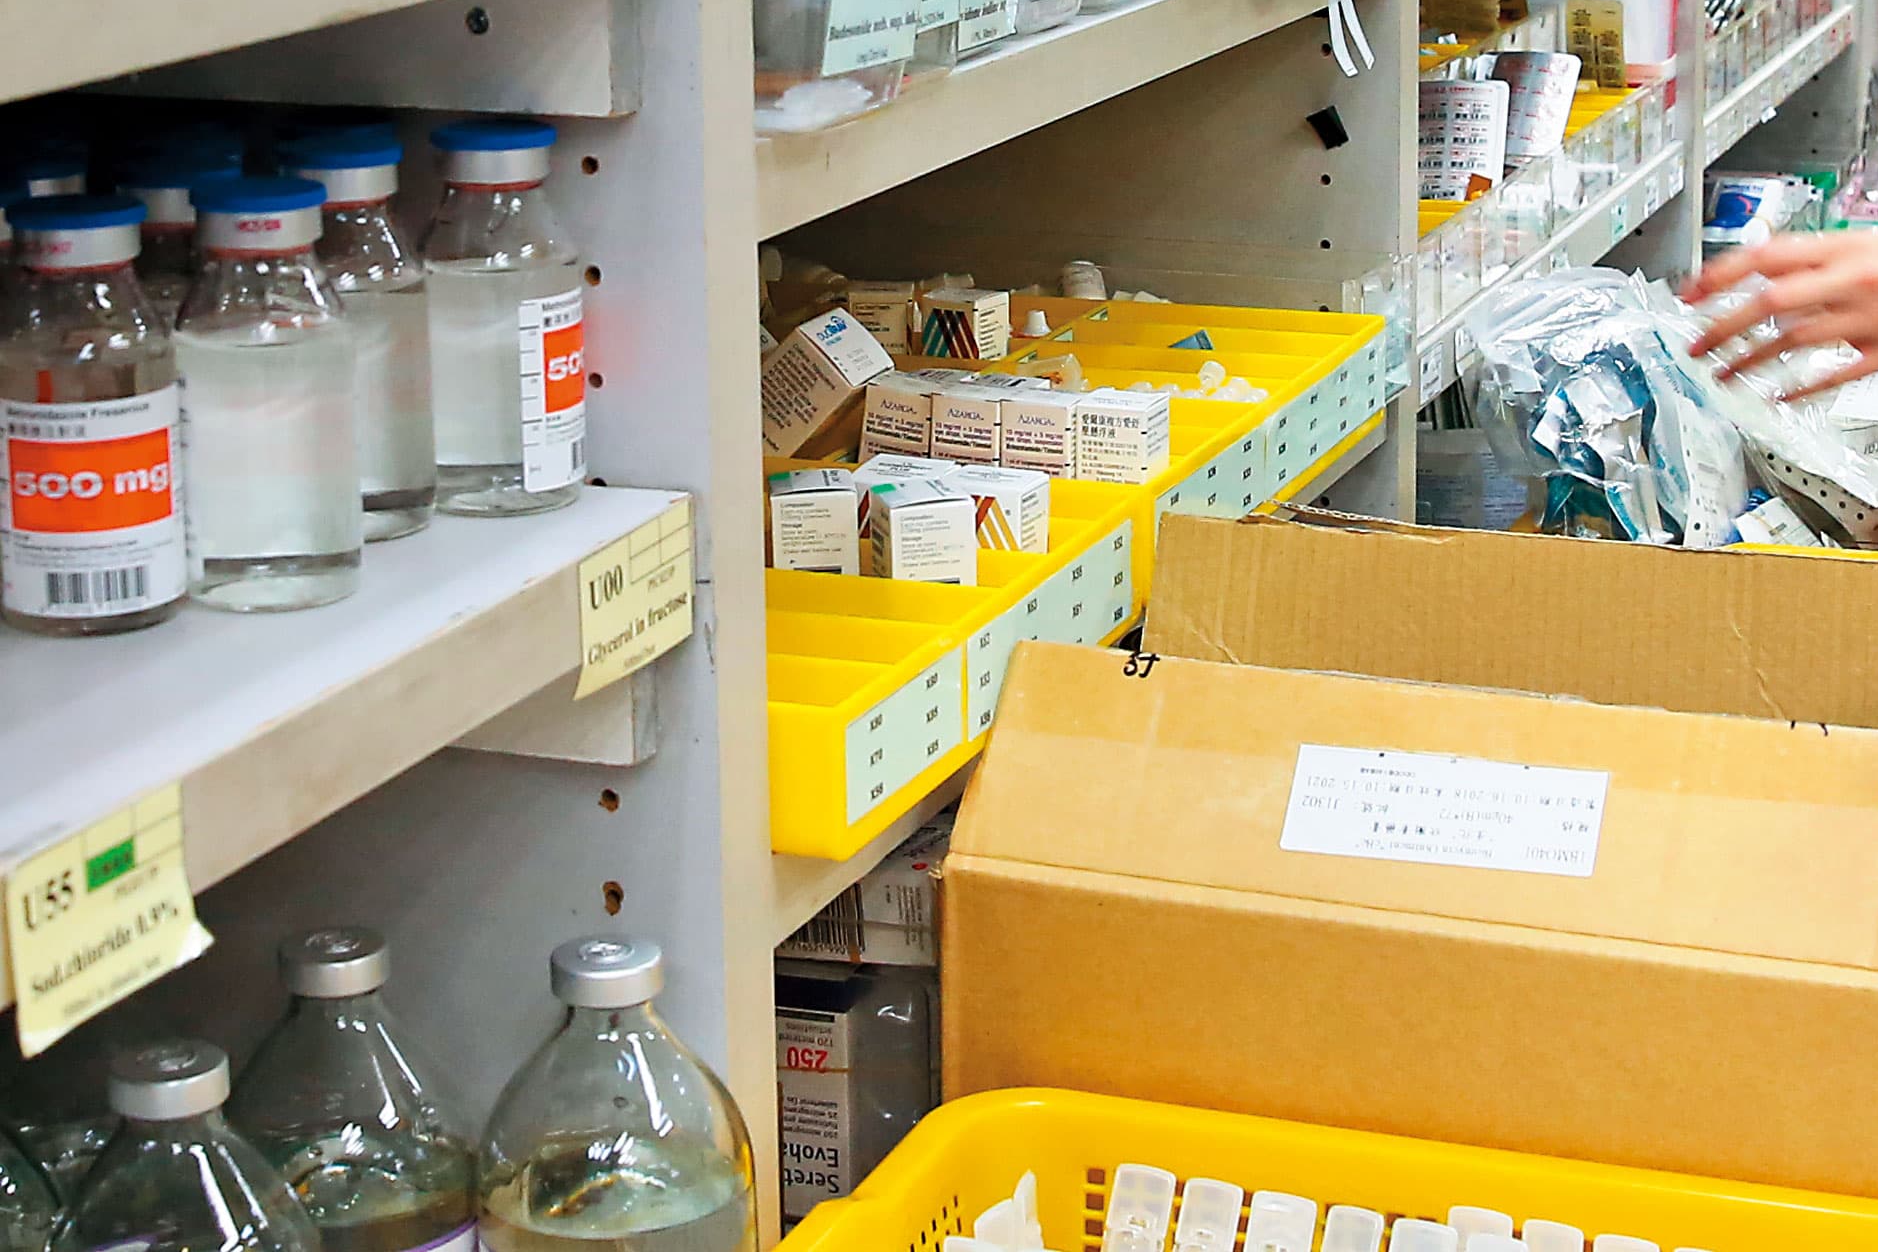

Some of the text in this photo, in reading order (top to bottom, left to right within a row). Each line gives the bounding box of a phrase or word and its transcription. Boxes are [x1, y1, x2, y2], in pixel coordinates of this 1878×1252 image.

[547, 348, 584, 381] 50
[14, 461, 169, 500] 500 mg
[588, 564, 624, 610] U00
[588, 623, 633, 666] Glycerol
[648, 591, 688, 628] fructose
[22, 868, 74, 933] U55
[786, 1047, 829, 1073] 250
[782, 1126, 822, 1138] microgram
[781, 1143, 840, 1168] Evoha
[782, 1167, 840, 1195] Seret
